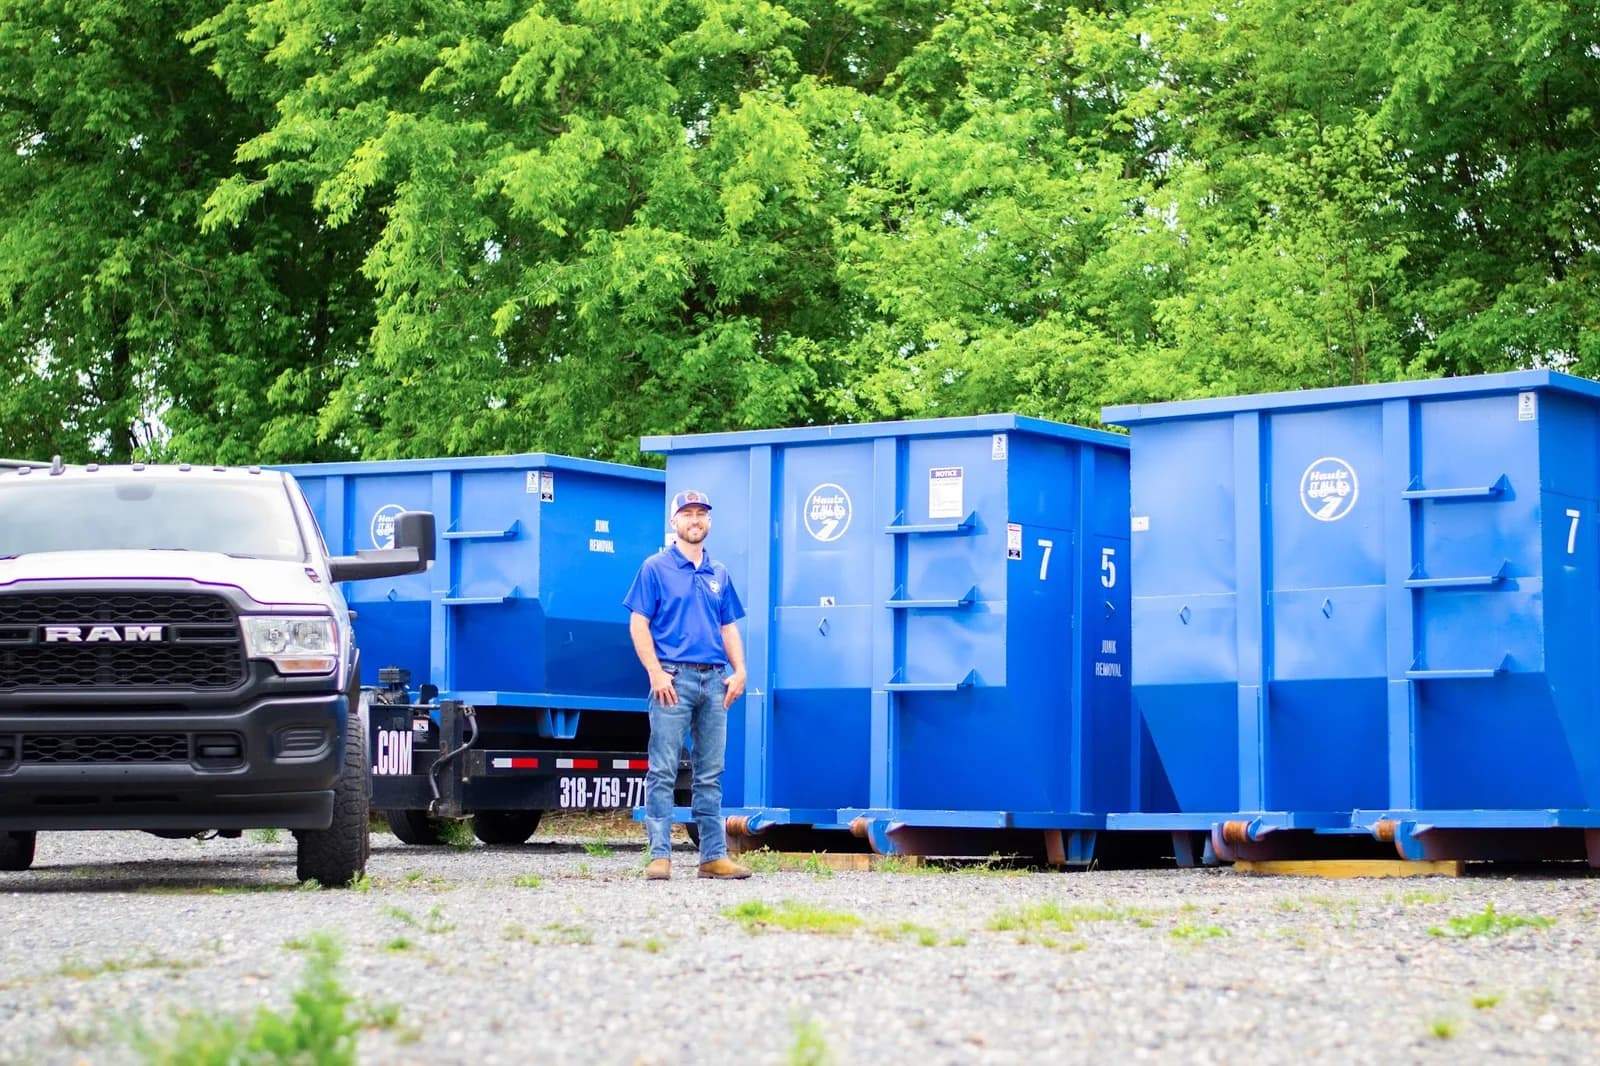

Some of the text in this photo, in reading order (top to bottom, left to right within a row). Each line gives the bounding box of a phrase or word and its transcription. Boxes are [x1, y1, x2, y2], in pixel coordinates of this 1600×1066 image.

[1566, 508, 1580, 554] 7
[589, 538, 615, 554] REMOVAL
[1037, 538, 1053, 581] 7
[1101, 547, 1116, 588] 5
[45, 626, 162, 642] RAM
[1101, 639, 1117, 655] JUNK
[1095, 661, 1122, 678] REMOVAL
